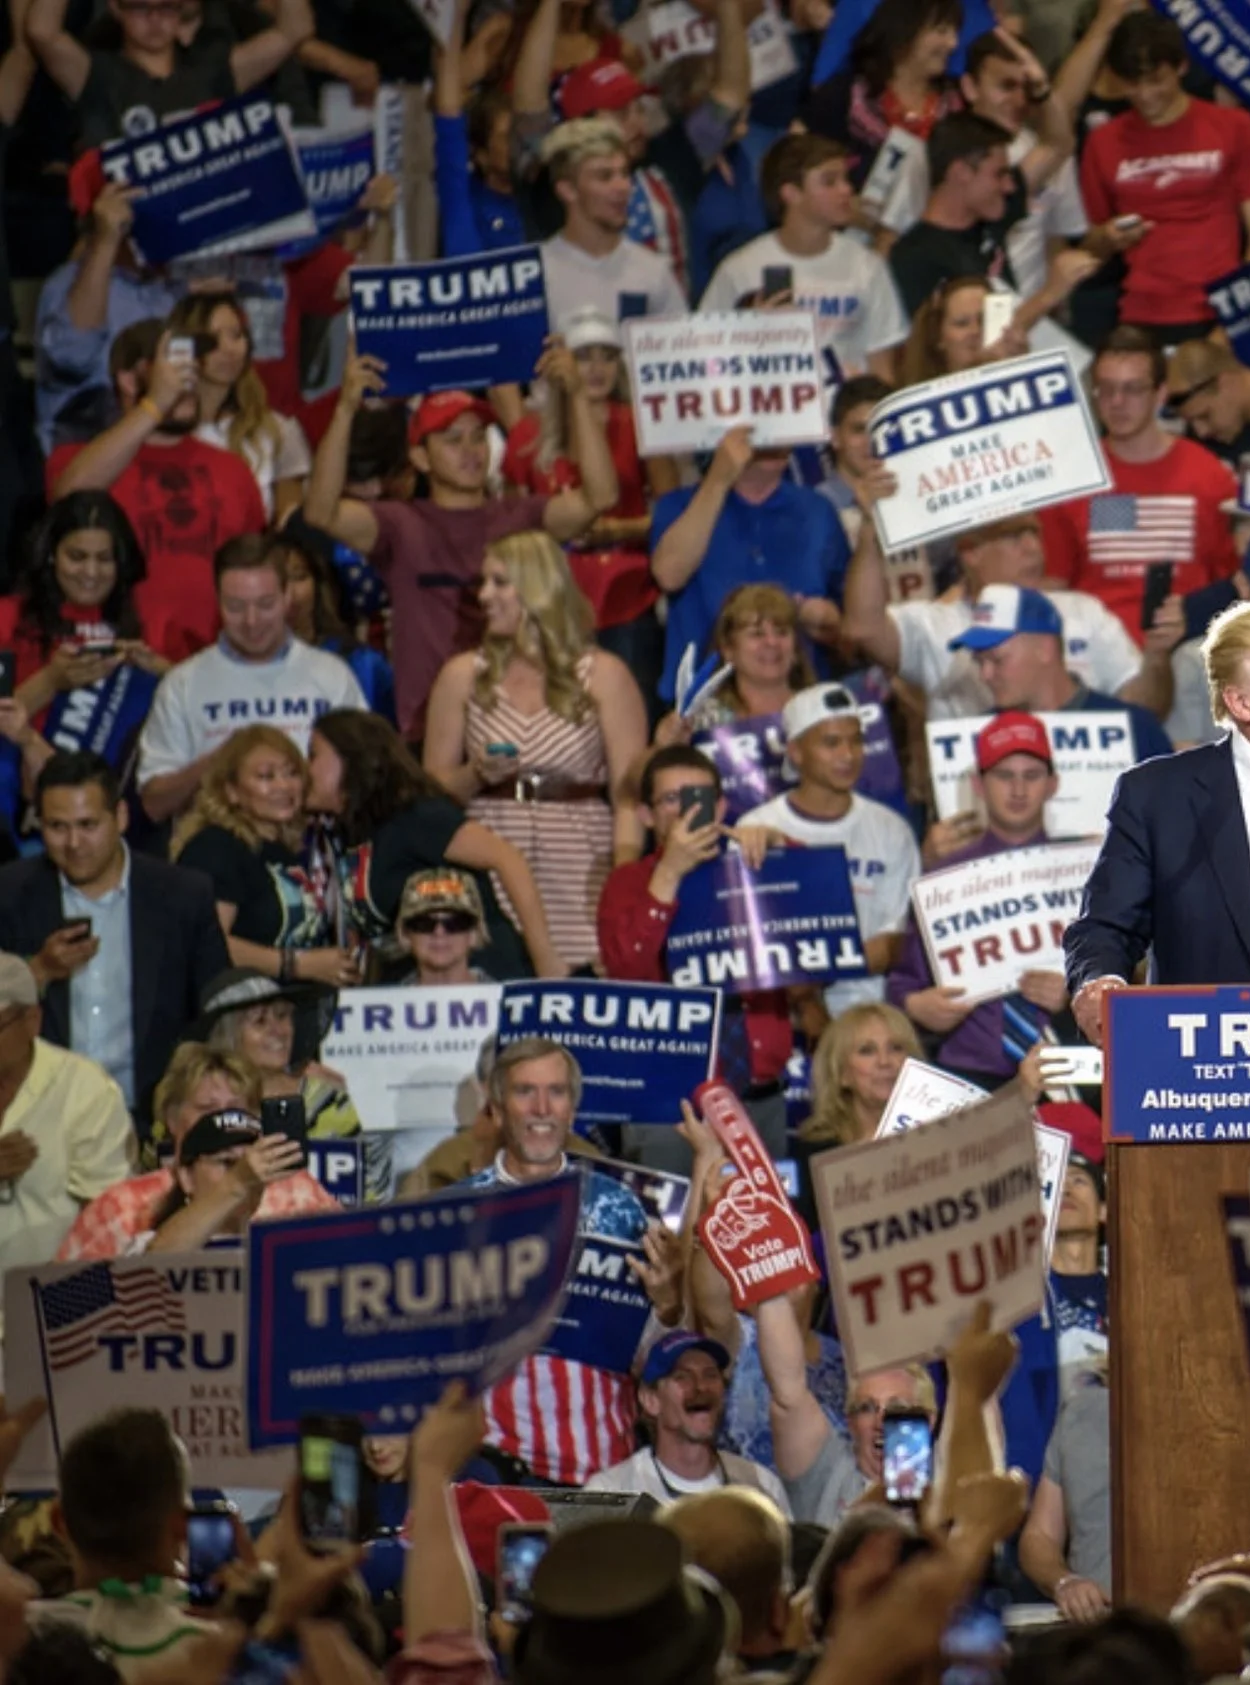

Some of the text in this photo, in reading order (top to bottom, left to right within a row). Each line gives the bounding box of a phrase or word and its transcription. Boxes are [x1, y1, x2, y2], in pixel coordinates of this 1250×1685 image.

[103, 101, 272, 182] TRUMP
[306, 161, 371, 201] UMP
[353, 259, 541, 310] TRUMP
[640, 353, 815, 383] STANDS WITH
[642, 384, 817, 422] TRUMP
[873, 371, 1068, 455] TRUMP
[951, 434, 1003, 458] MAKE
[916, 439, 1054, 497] AMERICA
[926, 485, 984, 514] GREAT
[204, 697, 330, 722] TRUMP
[695, 703, 881, 763] TRUP
[933, 726, 1125, 760] TMP
[924, 859, 1091, 910] the silent majorit
[932, 887, 1085, 939] STANDS WIT
[672, 937, 864, 988] TRUMP
[334, 999, 489, 1033] TRUM
[503, 993, 712, 1033] TRUMP
[610, 1036, 655, 1053] GREAT
[657, 1040, 709, 1056] AGAIN!
[1193, 1064, 1236, 1079] TEXT
[1149, 1123, 1206, 1140] MAKE
[833, 1172, 874, 1213] the
[882, 1153, 951, 1195] silent
[840, 1190, 979, 1260] STANDS
[978, 1166, 1034, 1210] WITH
[738, 1247, 806, 1286] TRUMP!
[743, 1236, 784, 1260] Vote
[293, 1236, 548, 1328] TRUMP
[848, 1214, 1047, 1327] TRUMP
[97, 1333, 236, 1372] TRU
[190, 1385, 233, 1399] MAK
